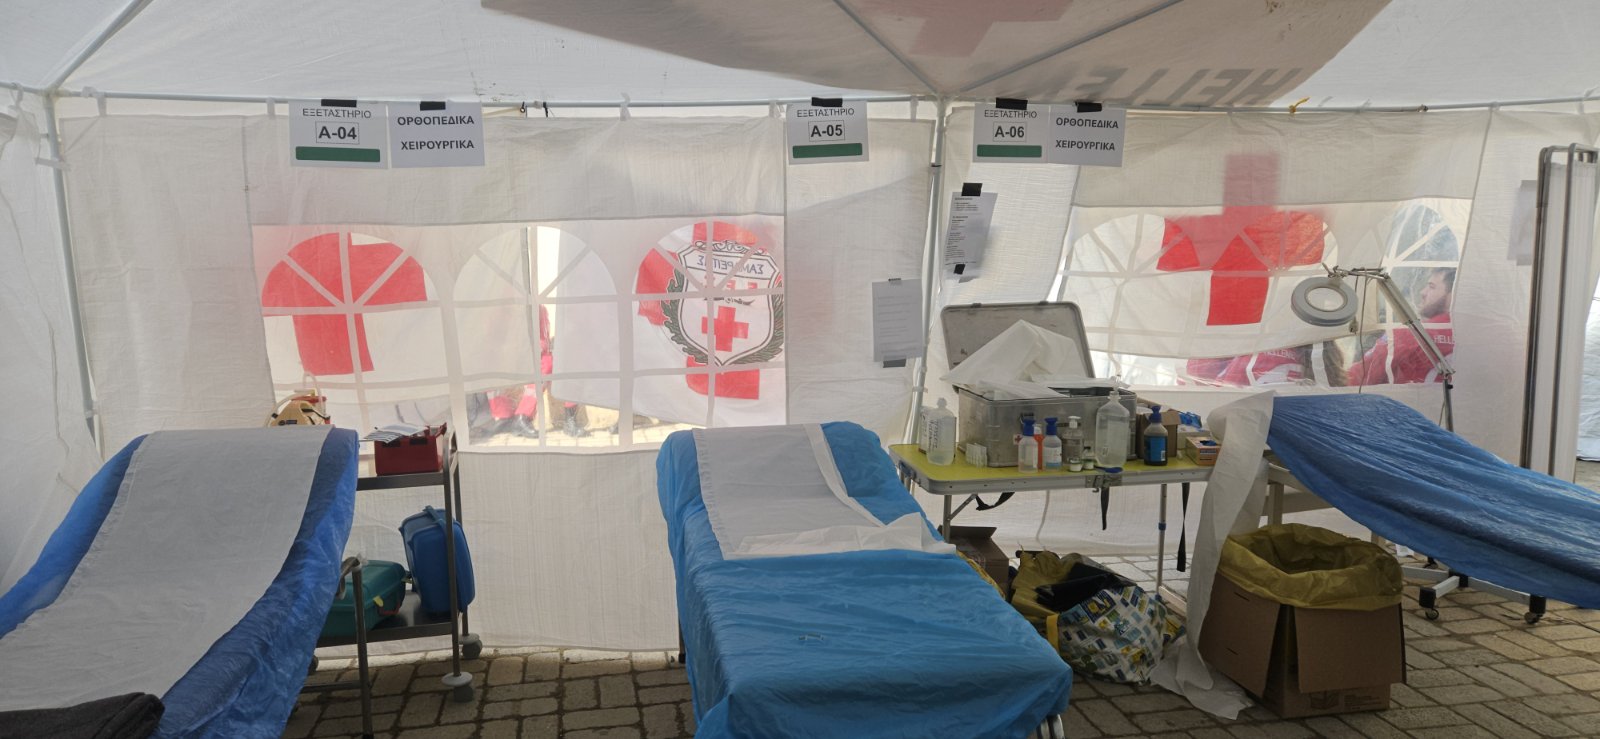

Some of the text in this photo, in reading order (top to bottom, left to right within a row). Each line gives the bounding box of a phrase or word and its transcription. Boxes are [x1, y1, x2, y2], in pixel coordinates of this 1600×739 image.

[302, 108, 372, 119] ΕΞΕΤΑΣΤΗΡΙΟ
[796, 108, 855, 118] ΕΞΕΤΑΣΤΗΡΙΟ
[984, 109, 1038, 119] ΕΞΕΤΑΣΤΗΡΙΟ
[397, 115, 475, 127] ΟΡΘΟΠΕΔΙΚΑ
[1055, 117, 1119, 129] ΟΡΘΟΠΕΔΙΚΑ
[318, 125, 357, 140] Α-04
[810, 124, 843, 138] Α-05
[994, 125, 1025, 138] Α-06
[401, 139, 475, 151] ΧΕΙΡΟΥΡΓΙΚΑ
[1055, 139, 1116, 151] ΧΕΙΡΟΥΡΓΙΚΑ
